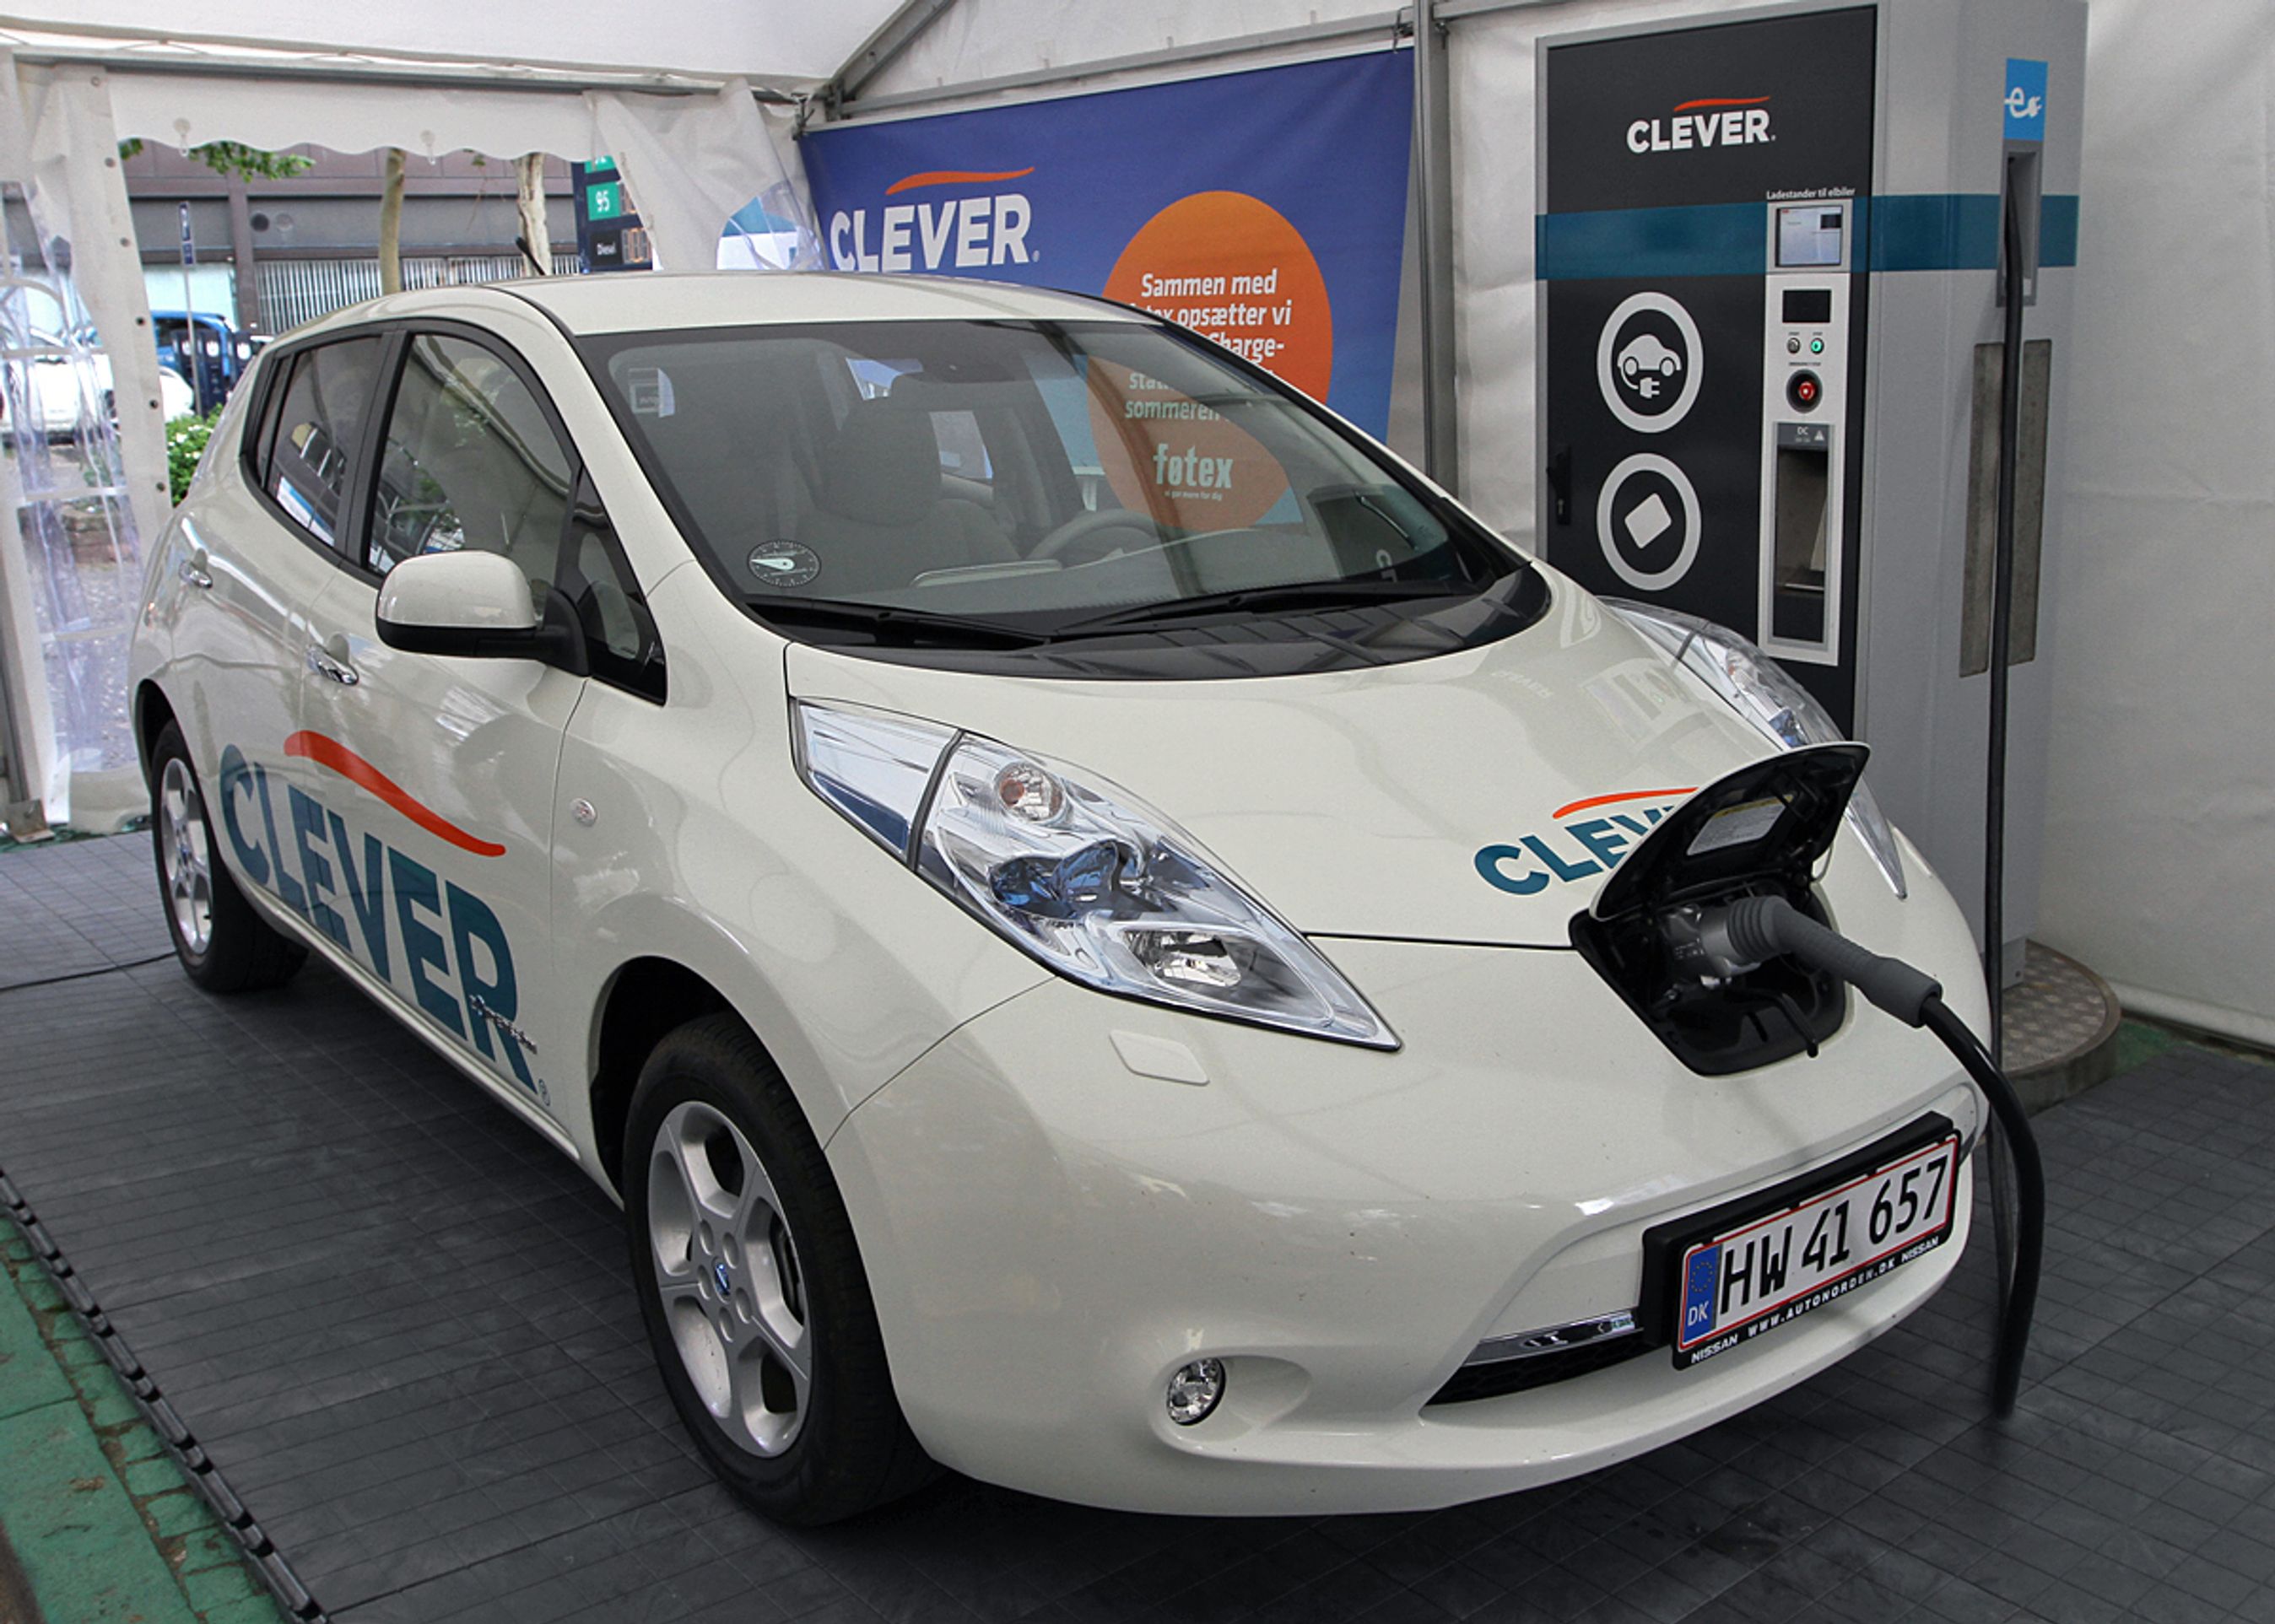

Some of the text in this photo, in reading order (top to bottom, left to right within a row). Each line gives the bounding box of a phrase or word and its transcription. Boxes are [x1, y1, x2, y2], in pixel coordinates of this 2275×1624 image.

[1626, 110, 1771, 154] CLEVER
[595, 189, 610, 212] 95
[1767, 186, 1856, 200] Ladestander til elbiler
[829, 192, 1032, 272] CLEVER
[1141, 267, 1278, 298] Sammen med
[1177, 301, 1267, 330] opsætter
[1272, 299, 1293, 326] vi
[1797, 426, 1808, 435] DC
[1153, 442, 1234, 489] føtex
[219, 743, 539, 1095] CLEVER
[1720, 1153, 1948, 1315] HW 41 657
[1687, 1300, 1710, 1328] DK
[1690, 1333, 1740, 1364] NISSAN
[1900, 1235, 1940, 1264] NISSAN
